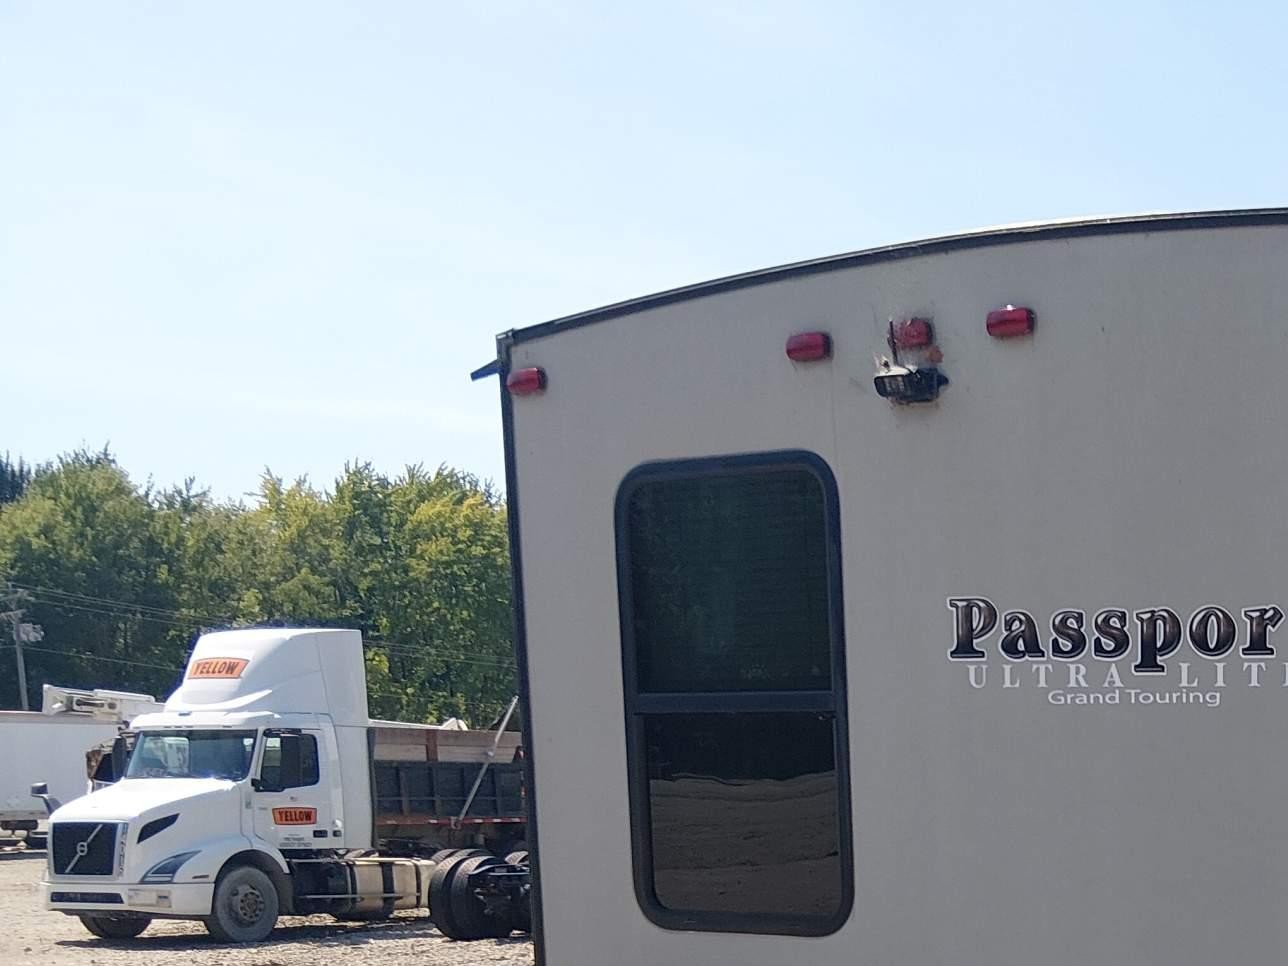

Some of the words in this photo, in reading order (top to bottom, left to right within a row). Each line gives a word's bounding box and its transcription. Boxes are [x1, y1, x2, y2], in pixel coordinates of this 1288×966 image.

[193, 660, 240, 676] YELLOW
[968, 663, 1125, 689] ULTRA
[1048, 689, 1120, 706] Grand
[1125, 688, 1221, 707] Touring
[278, 810, 313, 822] YELLOW
